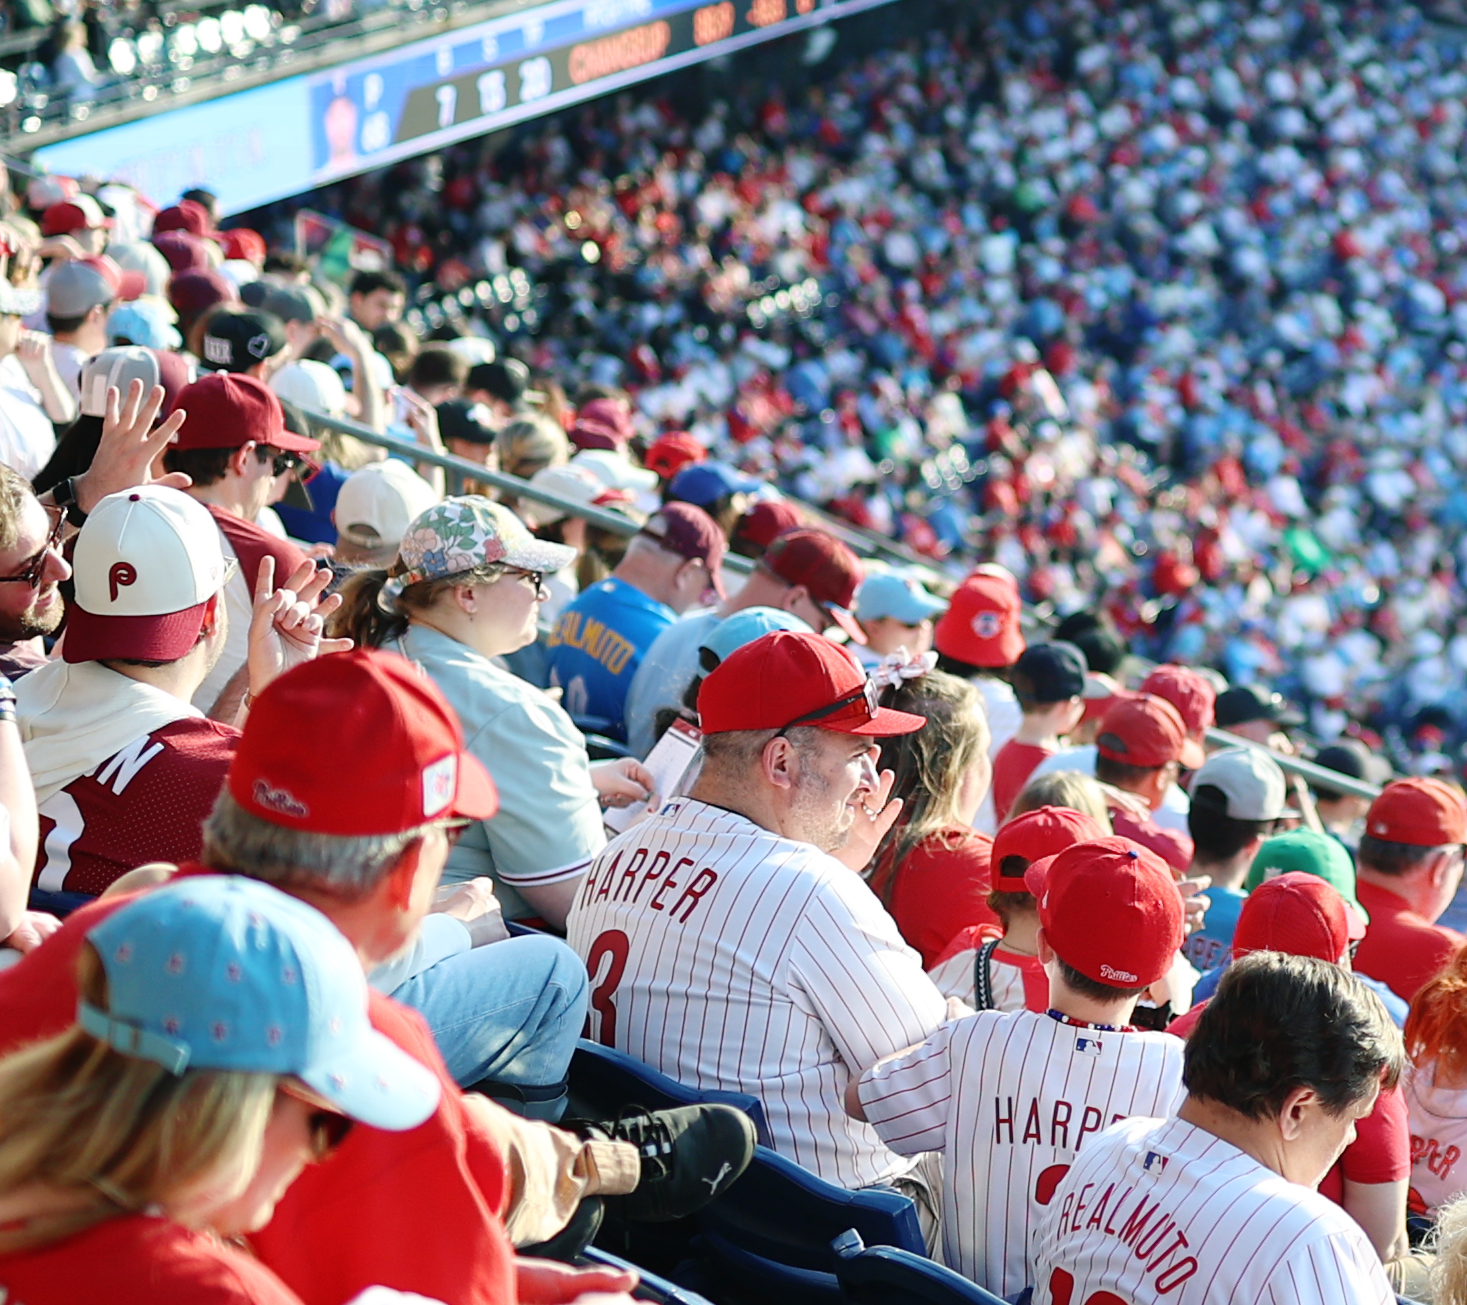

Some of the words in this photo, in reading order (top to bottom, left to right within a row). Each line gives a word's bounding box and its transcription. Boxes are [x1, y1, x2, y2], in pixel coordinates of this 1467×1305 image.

[108, 561, 137, 602] P
[580, 848, 718, 924] HARPER
[1099, 963, 1138, 983] Phillies
[994, 1096, 1130, 1152] HARP
[1056, 1181, 1199, 1296] REALMUTO
